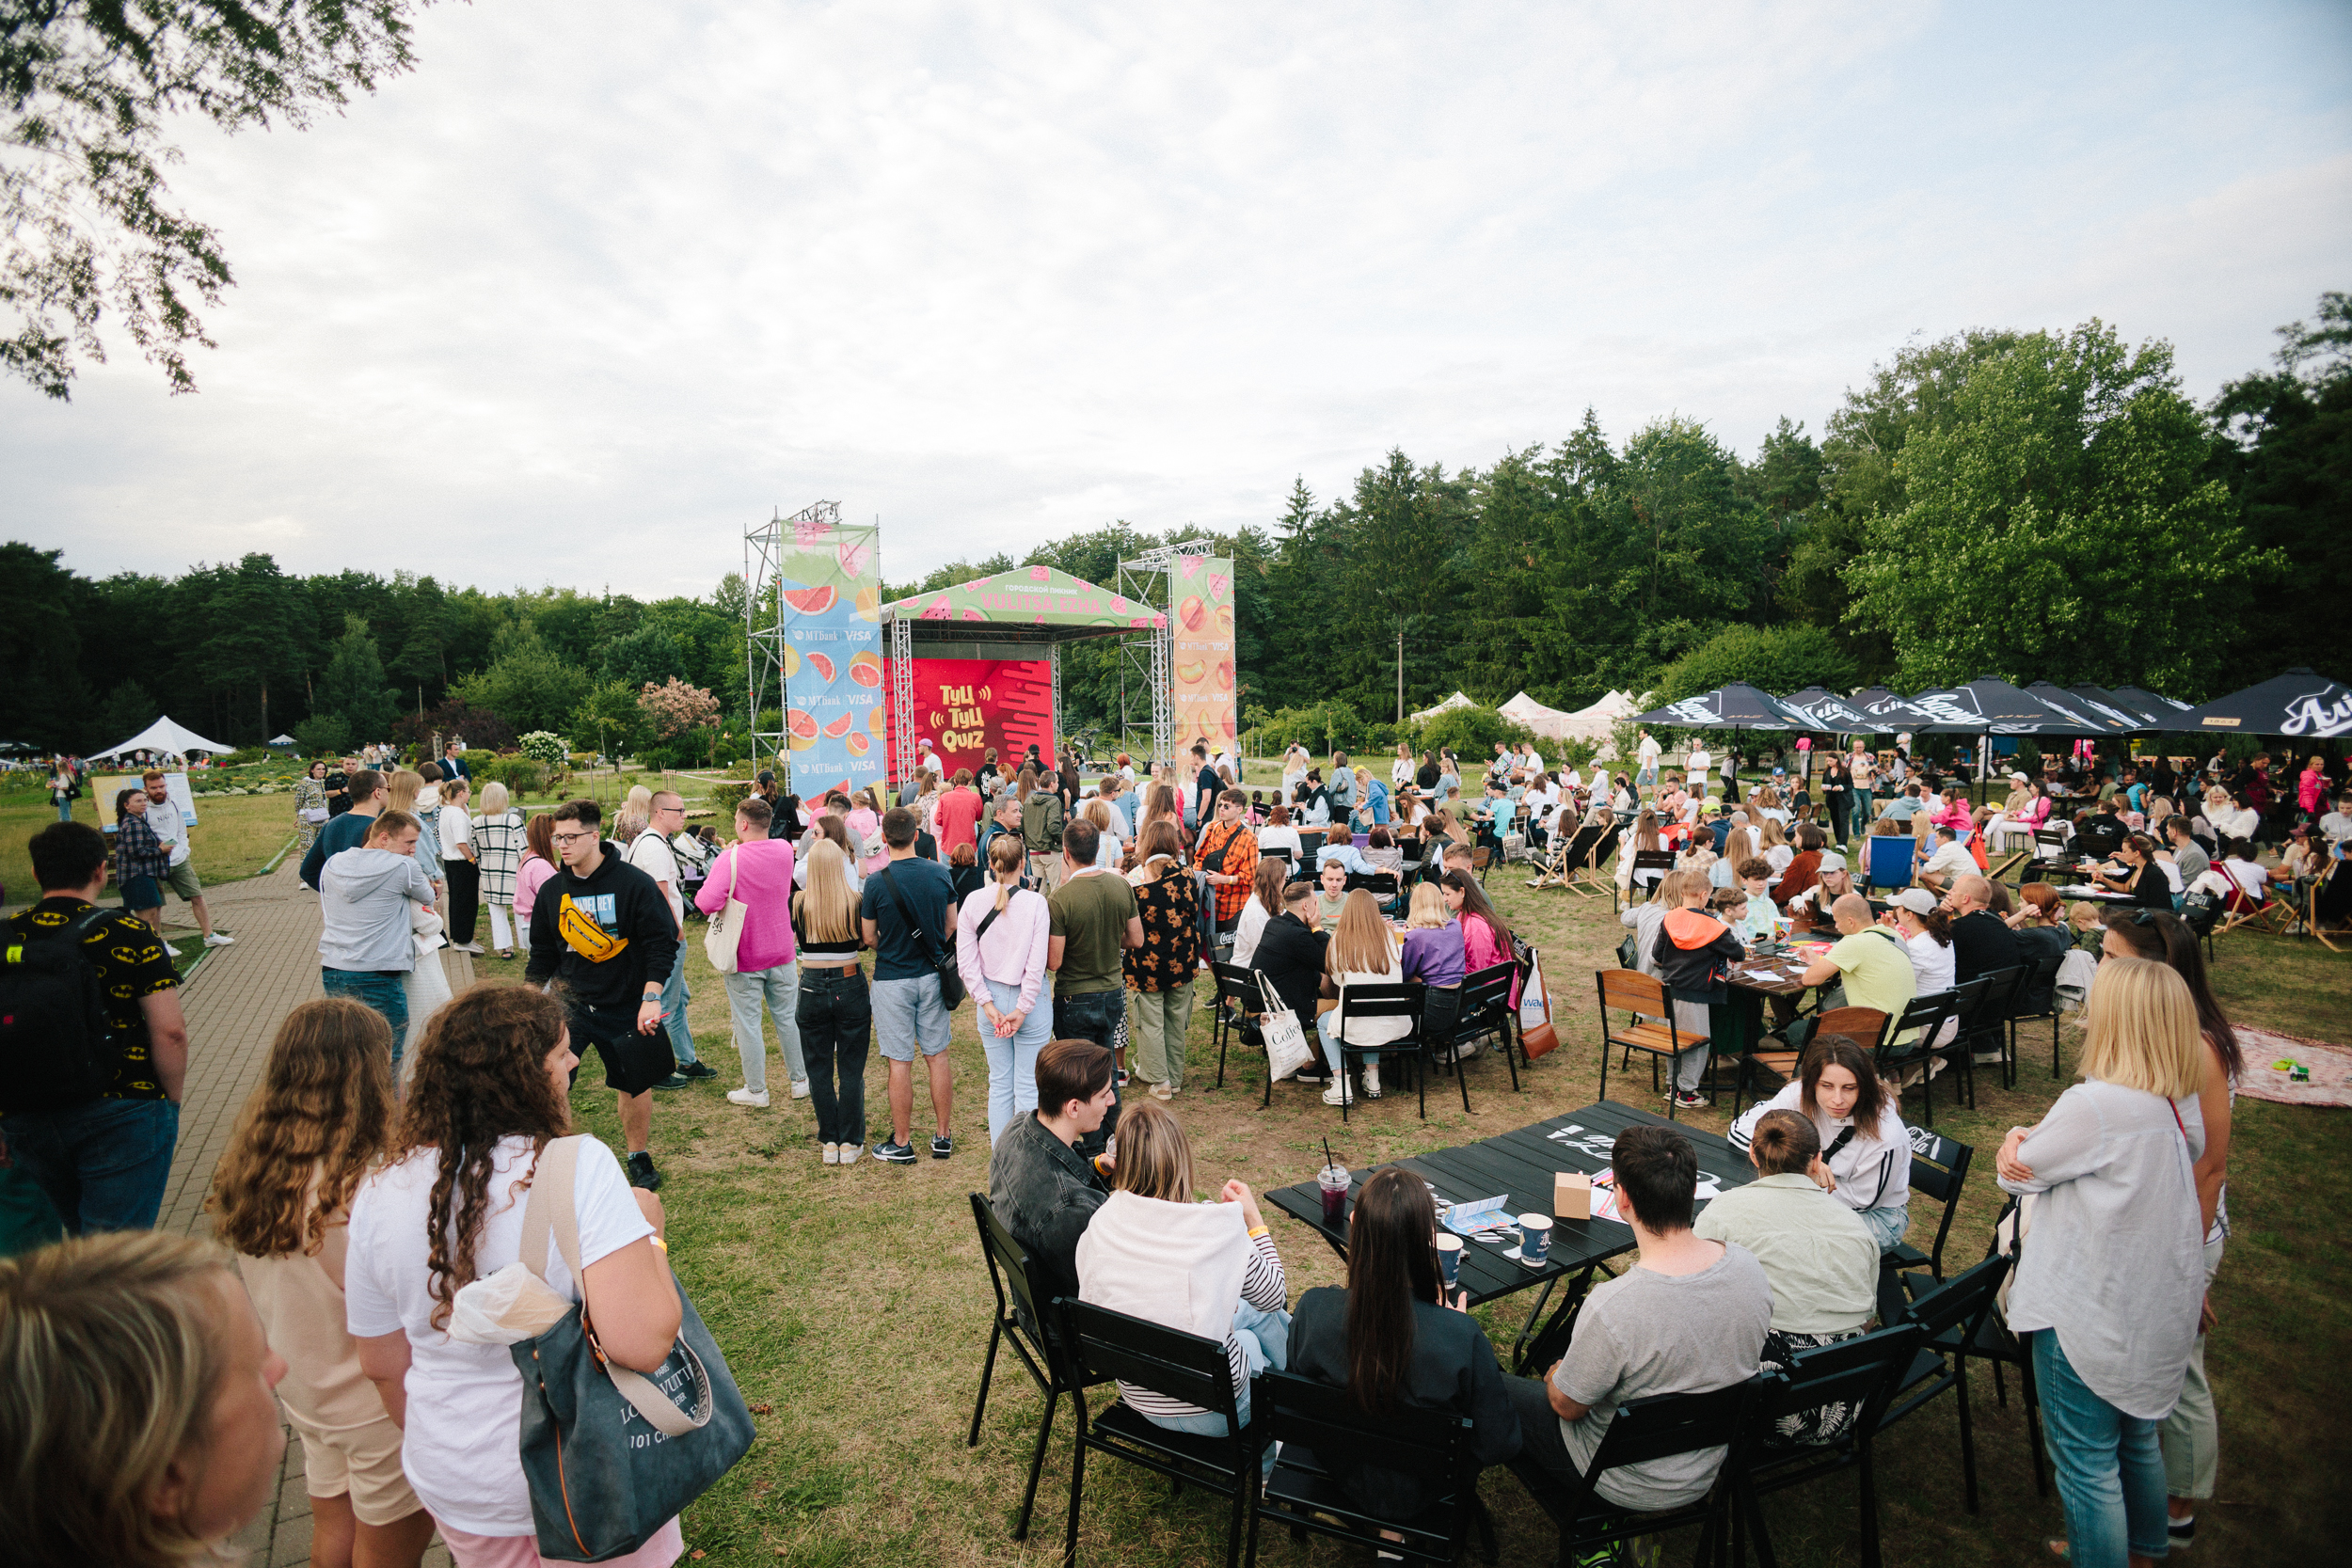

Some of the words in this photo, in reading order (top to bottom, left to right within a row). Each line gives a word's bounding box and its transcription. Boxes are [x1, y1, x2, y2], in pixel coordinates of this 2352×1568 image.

[1005, 584, 1048, 594] ГОРОДСКОЙ
[1050, 586, 1078, 595] ПИКНИК
[981, 593, 1055, 611] VULITSA
[1059, 597, 1102, 614] EZHA
[805, 630, 838, 641] МТБанк
[844, 630, 872, 641] VISA
[1212, 642, 1230, 651] VISA
[808, 695, 841, 705] МТБанк
[847, 694, 873, 705] VISA
[811, 763, 844, 773] МТБанк
[850, 761, 876, 771] VISA
[597, 895, 613, 911] REY
[1272, 1022, 1302, 1046] Coffee
[654, 1363, 670, 1378] PARIS
[630, 1433, 650, 1449] 101
